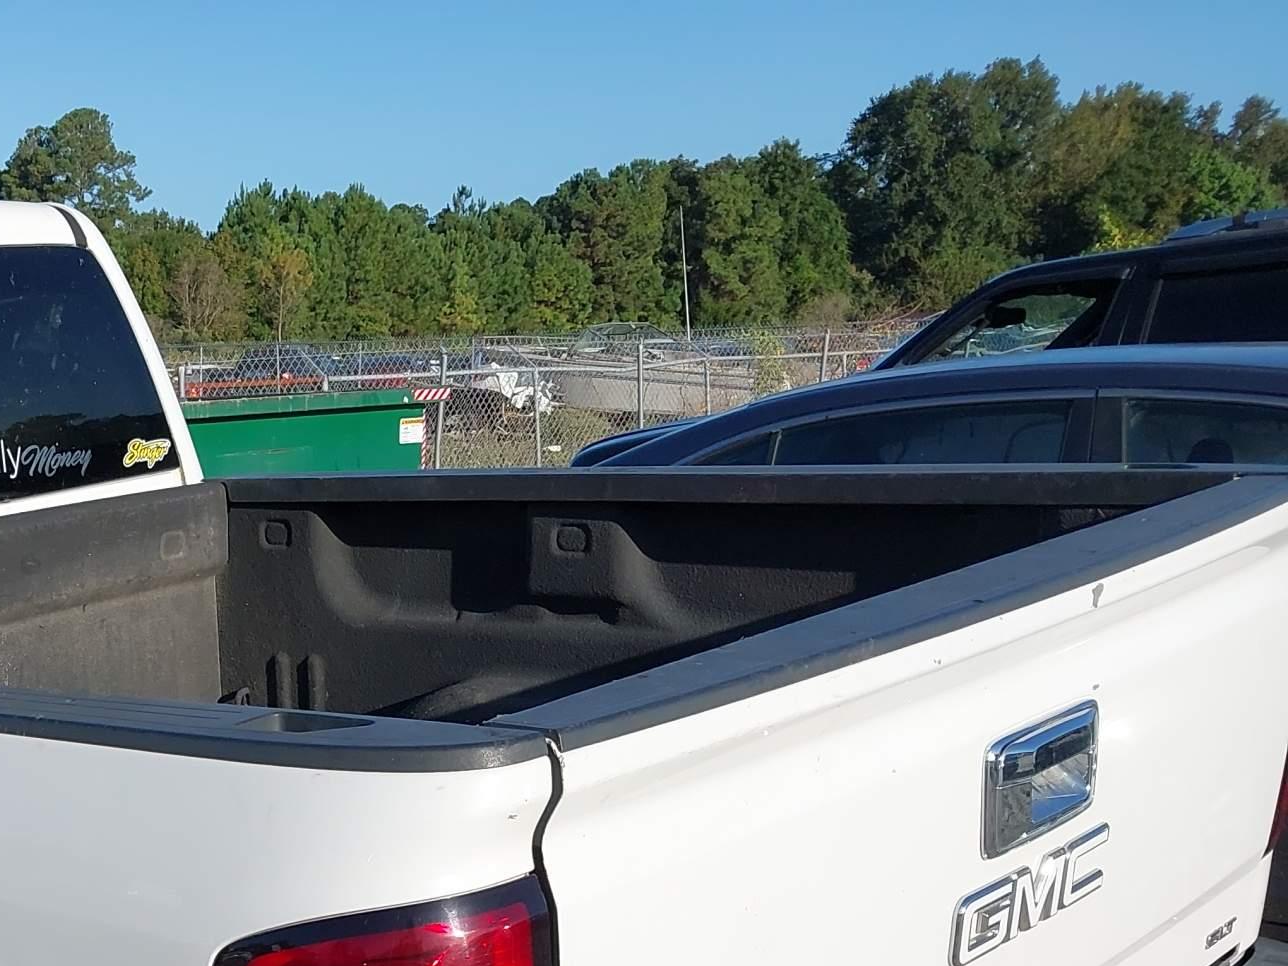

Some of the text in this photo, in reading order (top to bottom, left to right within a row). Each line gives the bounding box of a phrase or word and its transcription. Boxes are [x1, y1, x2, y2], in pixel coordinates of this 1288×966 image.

[21, 444, 92, 477] Money
[124, 439, 170, 468] Stinger
[1205, 916, 1238, 950] SLT
